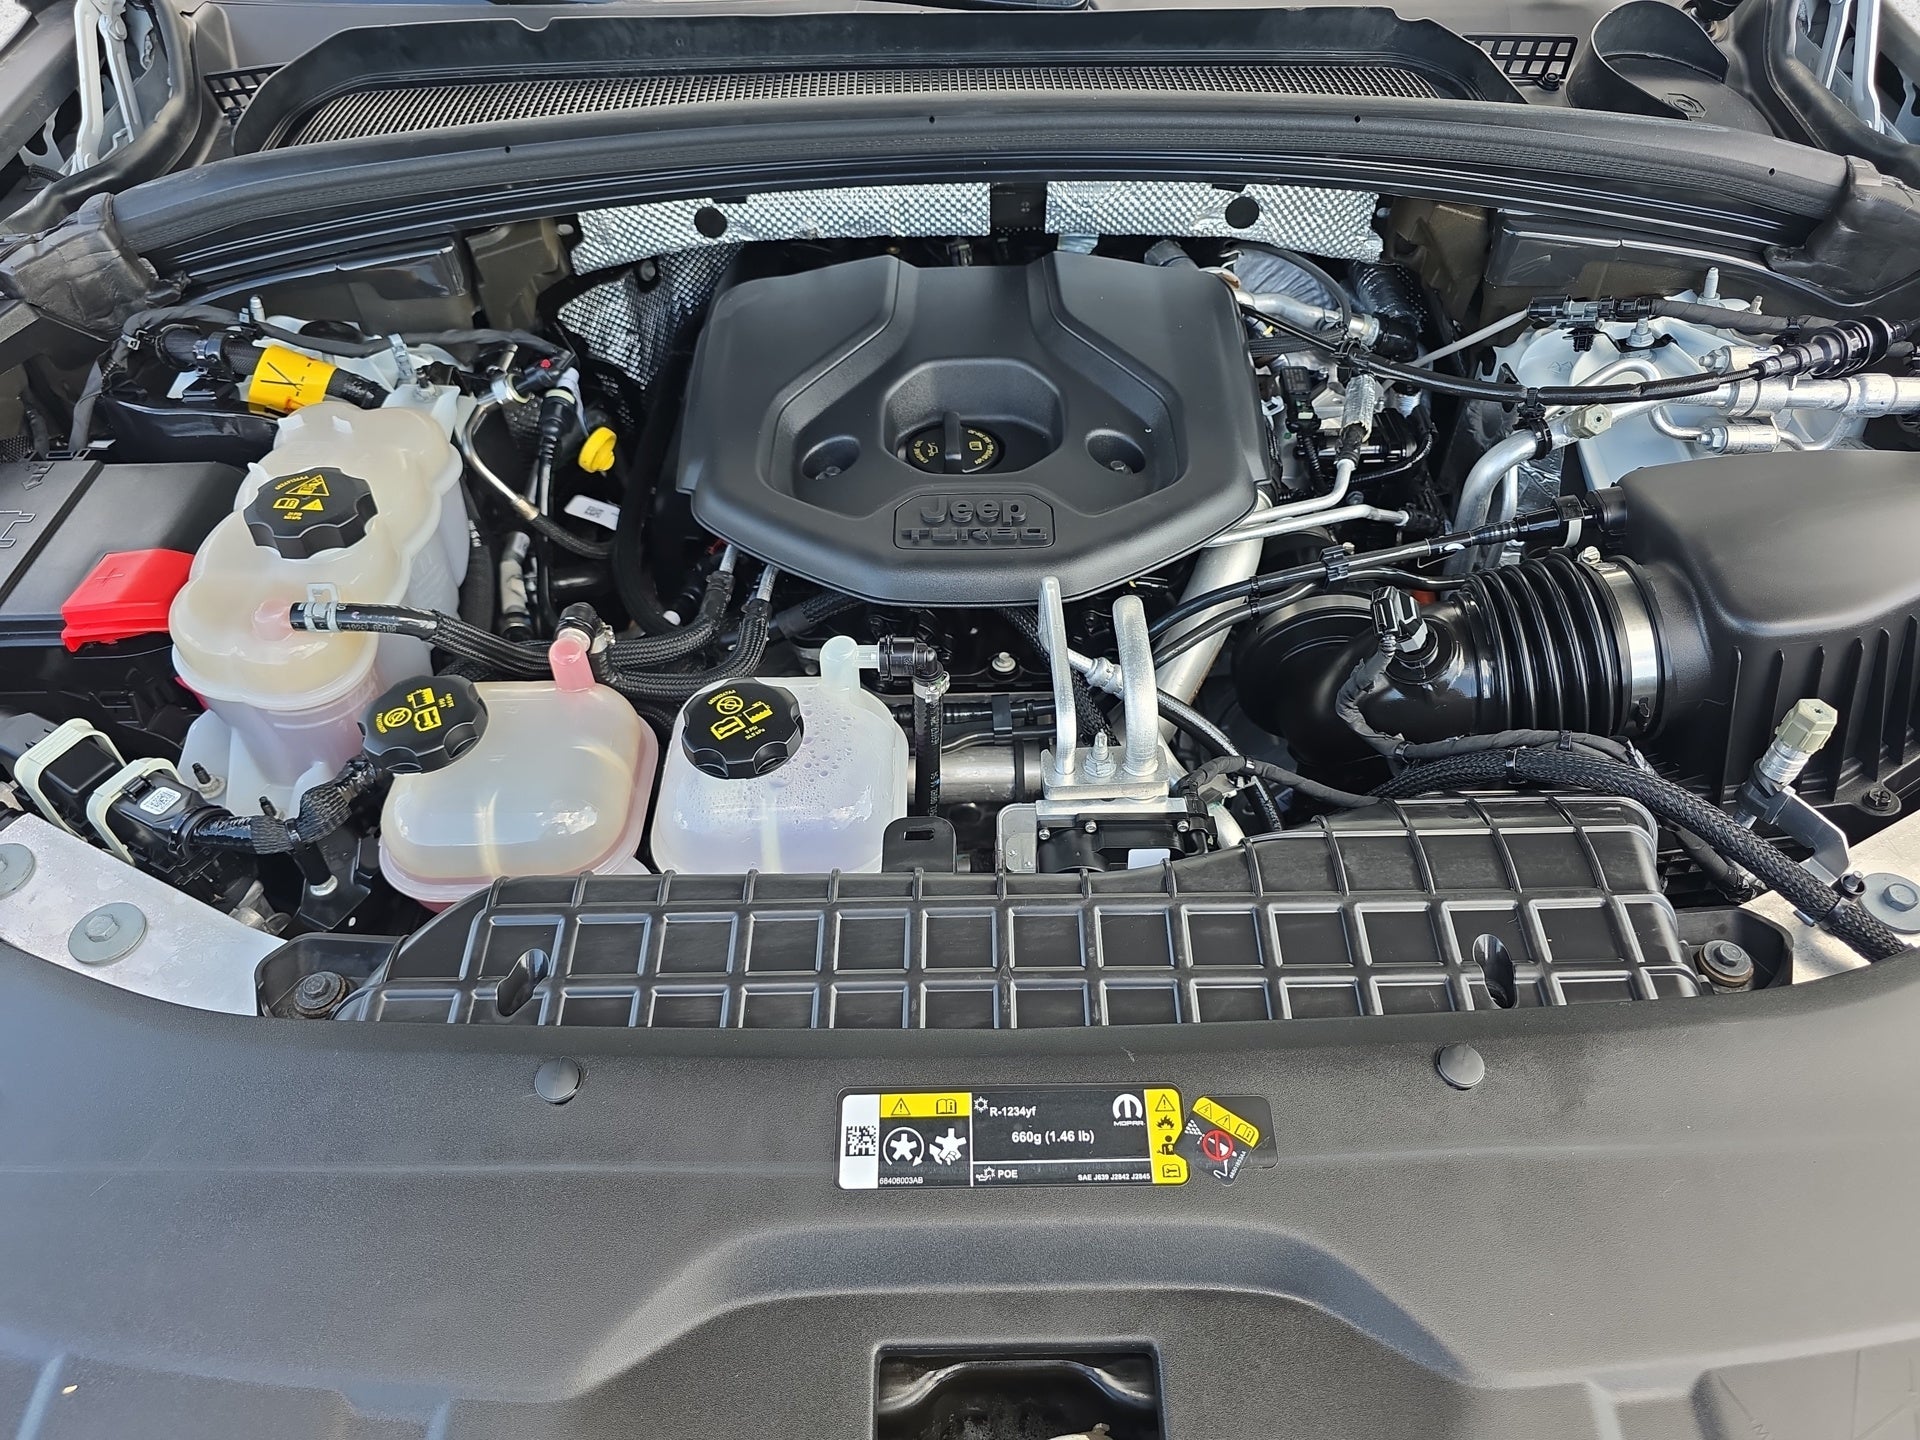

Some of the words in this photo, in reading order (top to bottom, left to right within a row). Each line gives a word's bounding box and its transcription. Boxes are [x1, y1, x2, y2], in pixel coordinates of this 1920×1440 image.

[920, 496, 1027, 527] Jeep
[901, 527, 1048, 545] TURBO
[989, 1105, 1037, 1119] R-1234yf
[1011, 1130, 1042, 1145] 660g
[1045, 1130, 1075, 1145] (1.46
[1078, 1129, 1095, 1144] lb)
[997, 1169, 1019, 1179] POE
[1077, 1173, 1093, 1181] SAE
[1131, 1172, 1151, 1180] J2845
